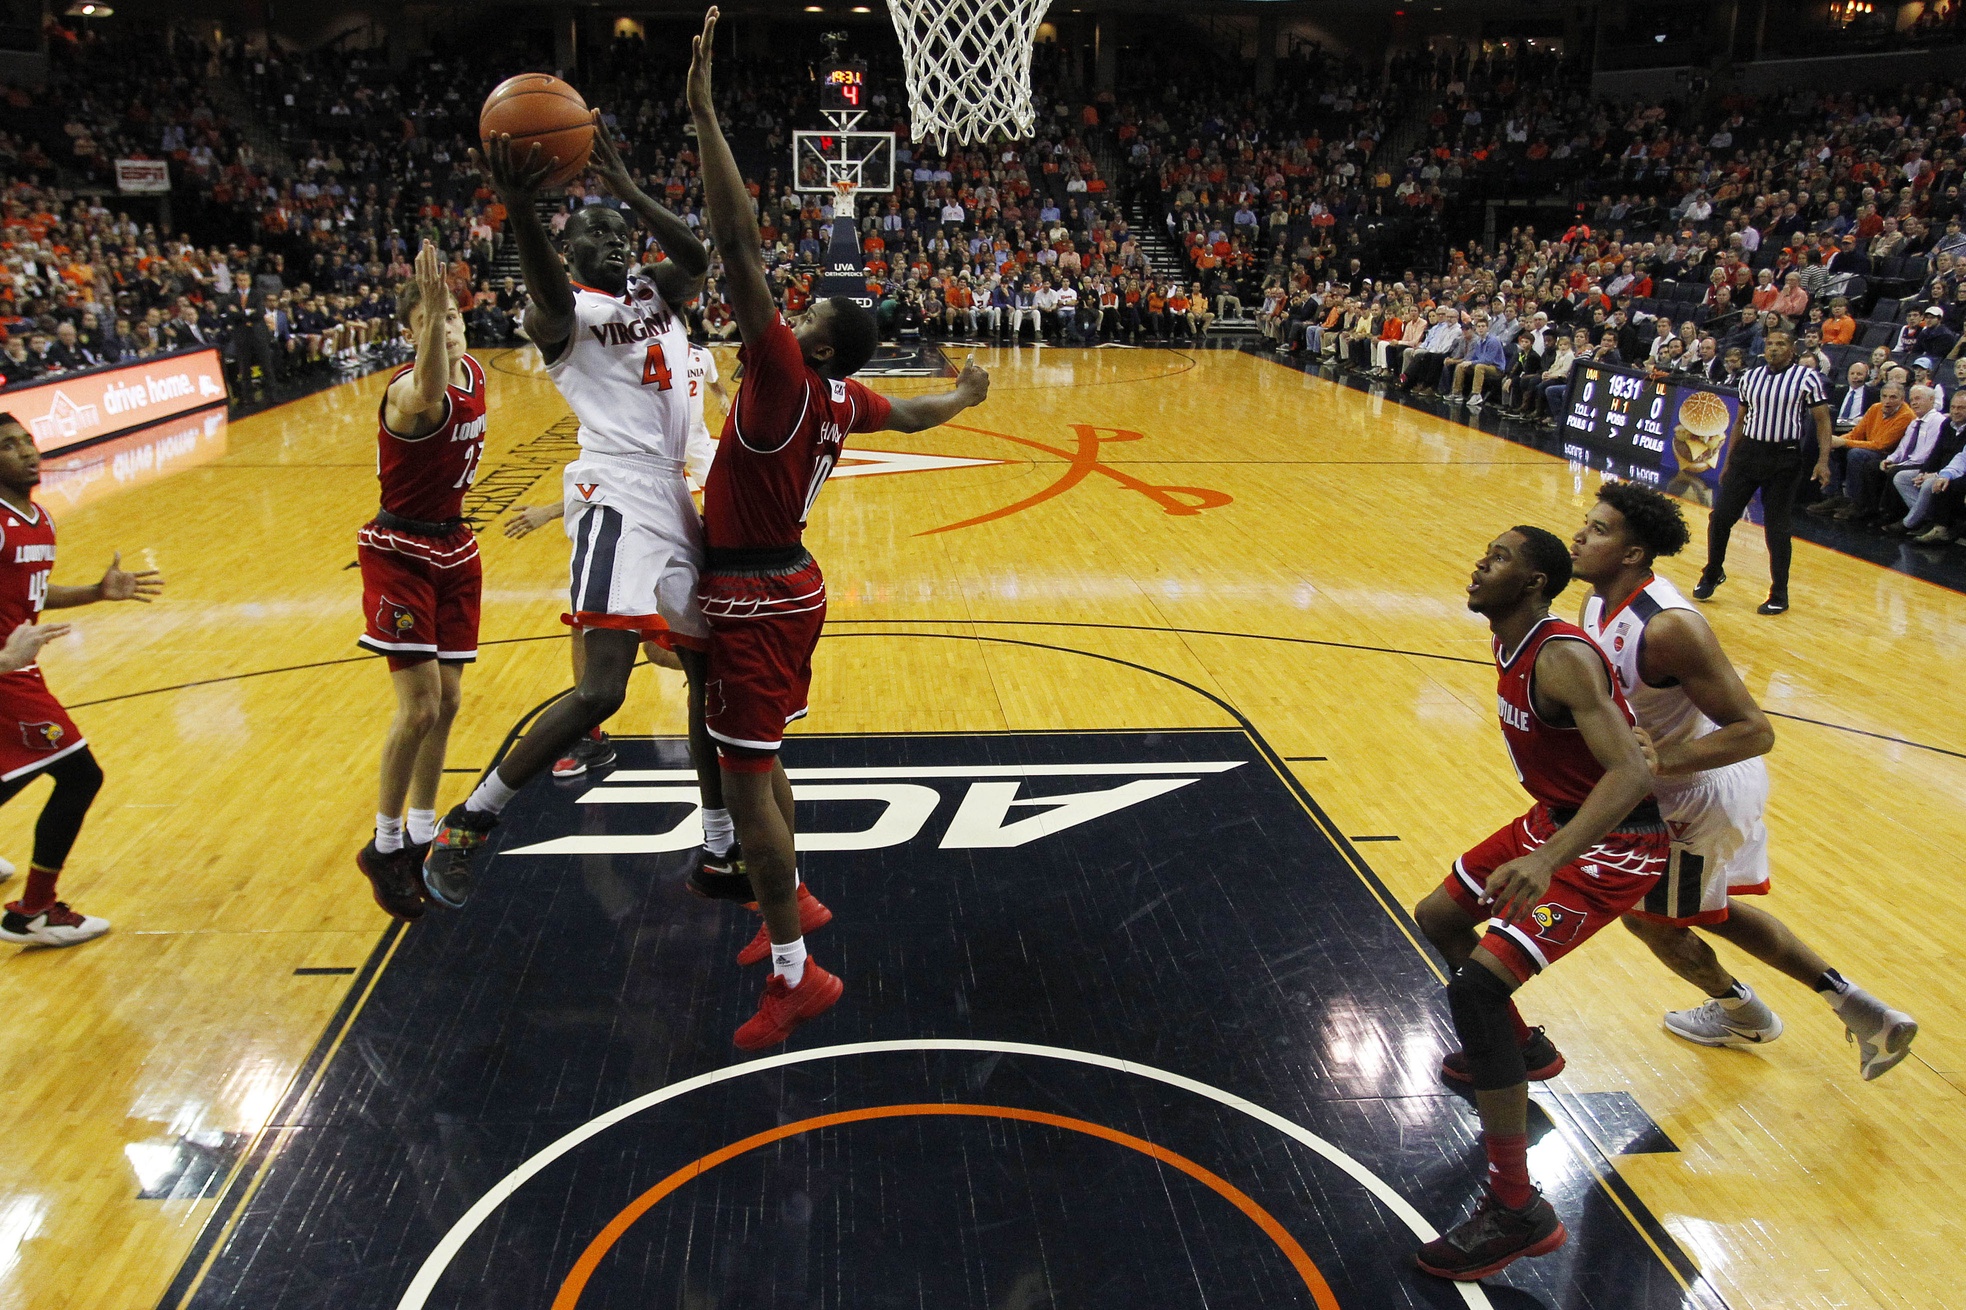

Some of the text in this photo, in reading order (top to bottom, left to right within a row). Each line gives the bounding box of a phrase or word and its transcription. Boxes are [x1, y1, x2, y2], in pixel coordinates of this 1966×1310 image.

[831, 70, 861, 84] 19:31
[842, 85, 859, 105] 4
[121, 166, 165, 180] ESPN
[834, 263, 855, 271] UVA
[589, 310, 674, 348] VIRGNIA
[641, 343, 673, 391] 4
[1585, 368, 1599, 381] UVA
[103, 373, 195, 415] drive home.
[1583, 381, 1595, 402] 0
[1609, 374, 1643, 400] 19:31
[1589, 406, 1596, 419] 4
[1610, 397, 1630, 413] H 1
[1650, 397, 1663, 420] 0
[1566, 414, 1593, 433] FOULS 0
[1606, 411, 1625, 427] POSS
[1636, 418, 1642, 430] 4
[1632, 433, 1664, 452] 0 FOULS
[453, 442, 485, 488] 23
[799, 454, 833, 523] 10
[28, 569, 50, 613] 45
[500, 777, 1204, 856] ACC
